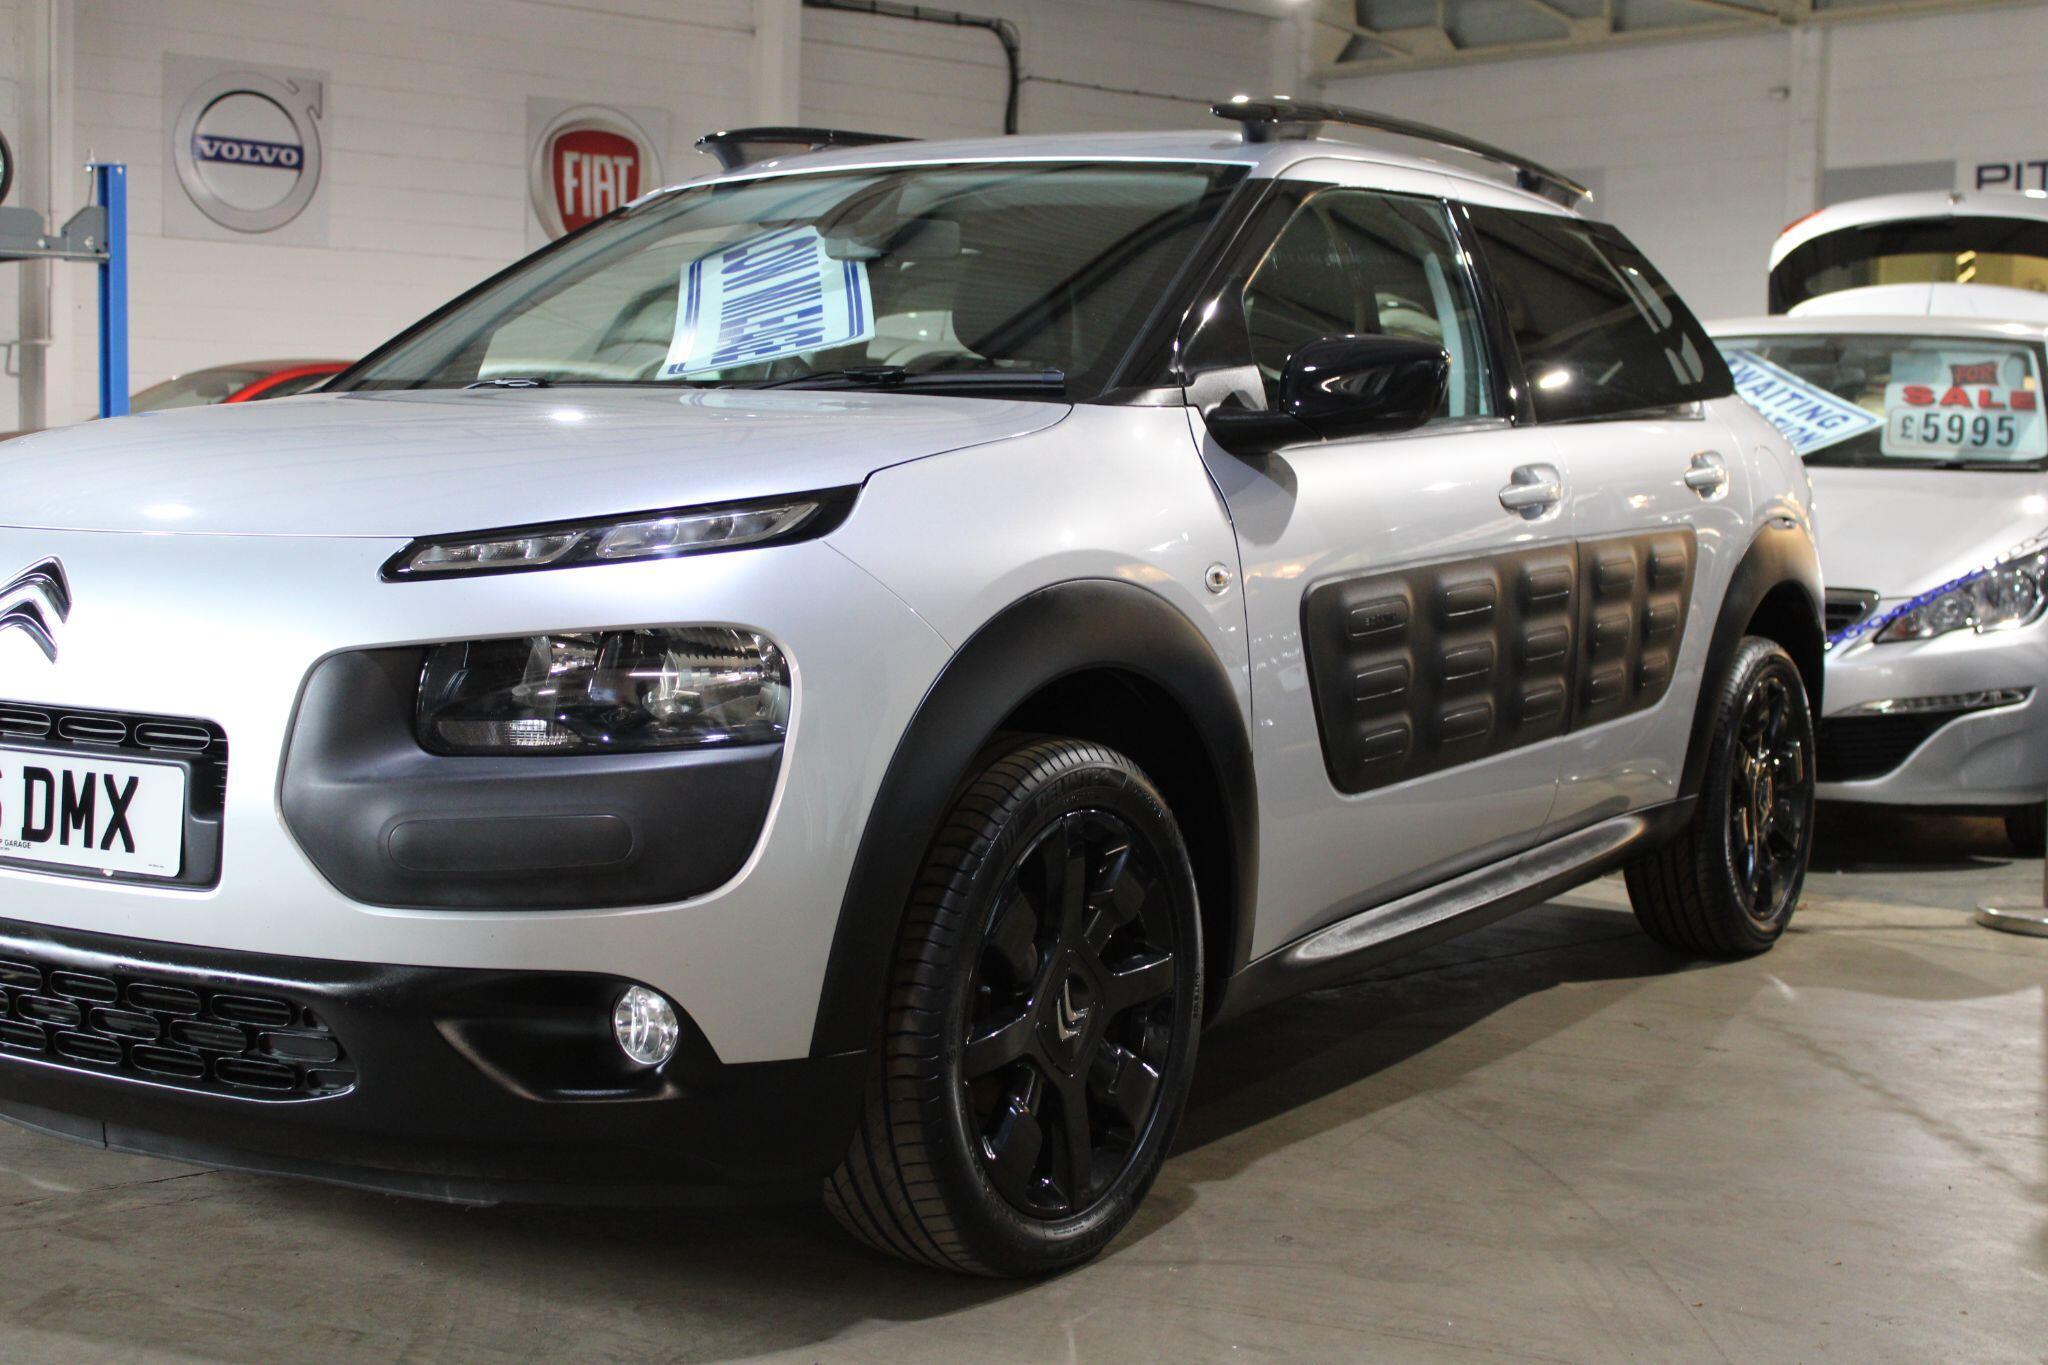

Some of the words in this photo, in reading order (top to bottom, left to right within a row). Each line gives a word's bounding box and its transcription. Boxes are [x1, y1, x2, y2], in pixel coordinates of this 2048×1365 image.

[197, 139, 300, 166] VOLVO
[563, 150, 633, 218] FIAT
[1728, 358, 1850, 430] WAITING
[1903, 385, 2037, 411] SALE
[22, 766, 139, 854] DMX
[5, 840, 31, 849] GARAGE
